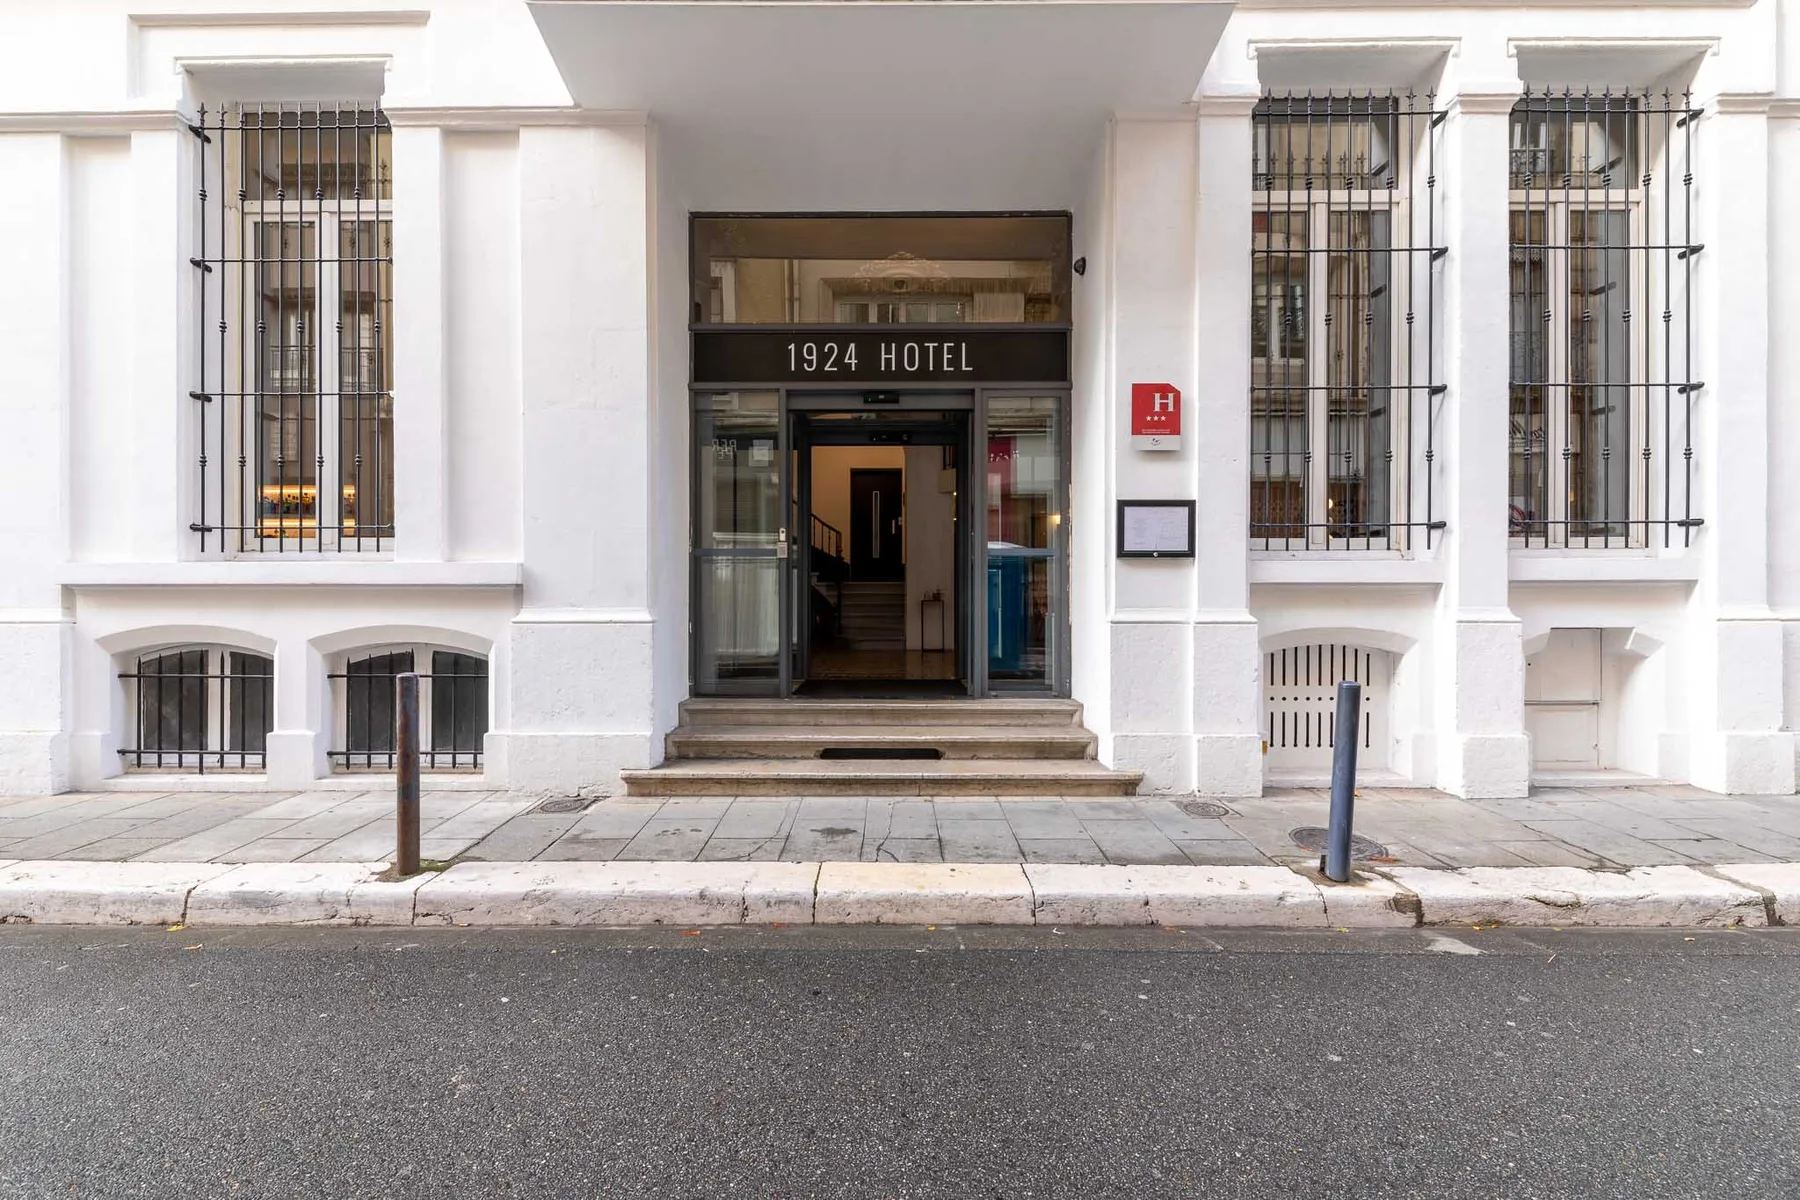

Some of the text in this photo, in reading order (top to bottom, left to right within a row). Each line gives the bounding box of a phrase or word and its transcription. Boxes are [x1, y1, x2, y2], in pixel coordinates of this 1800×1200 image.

[788, 342, 973, 371] 1924 HOTEL
[1153, 392, 1176, 412] H
